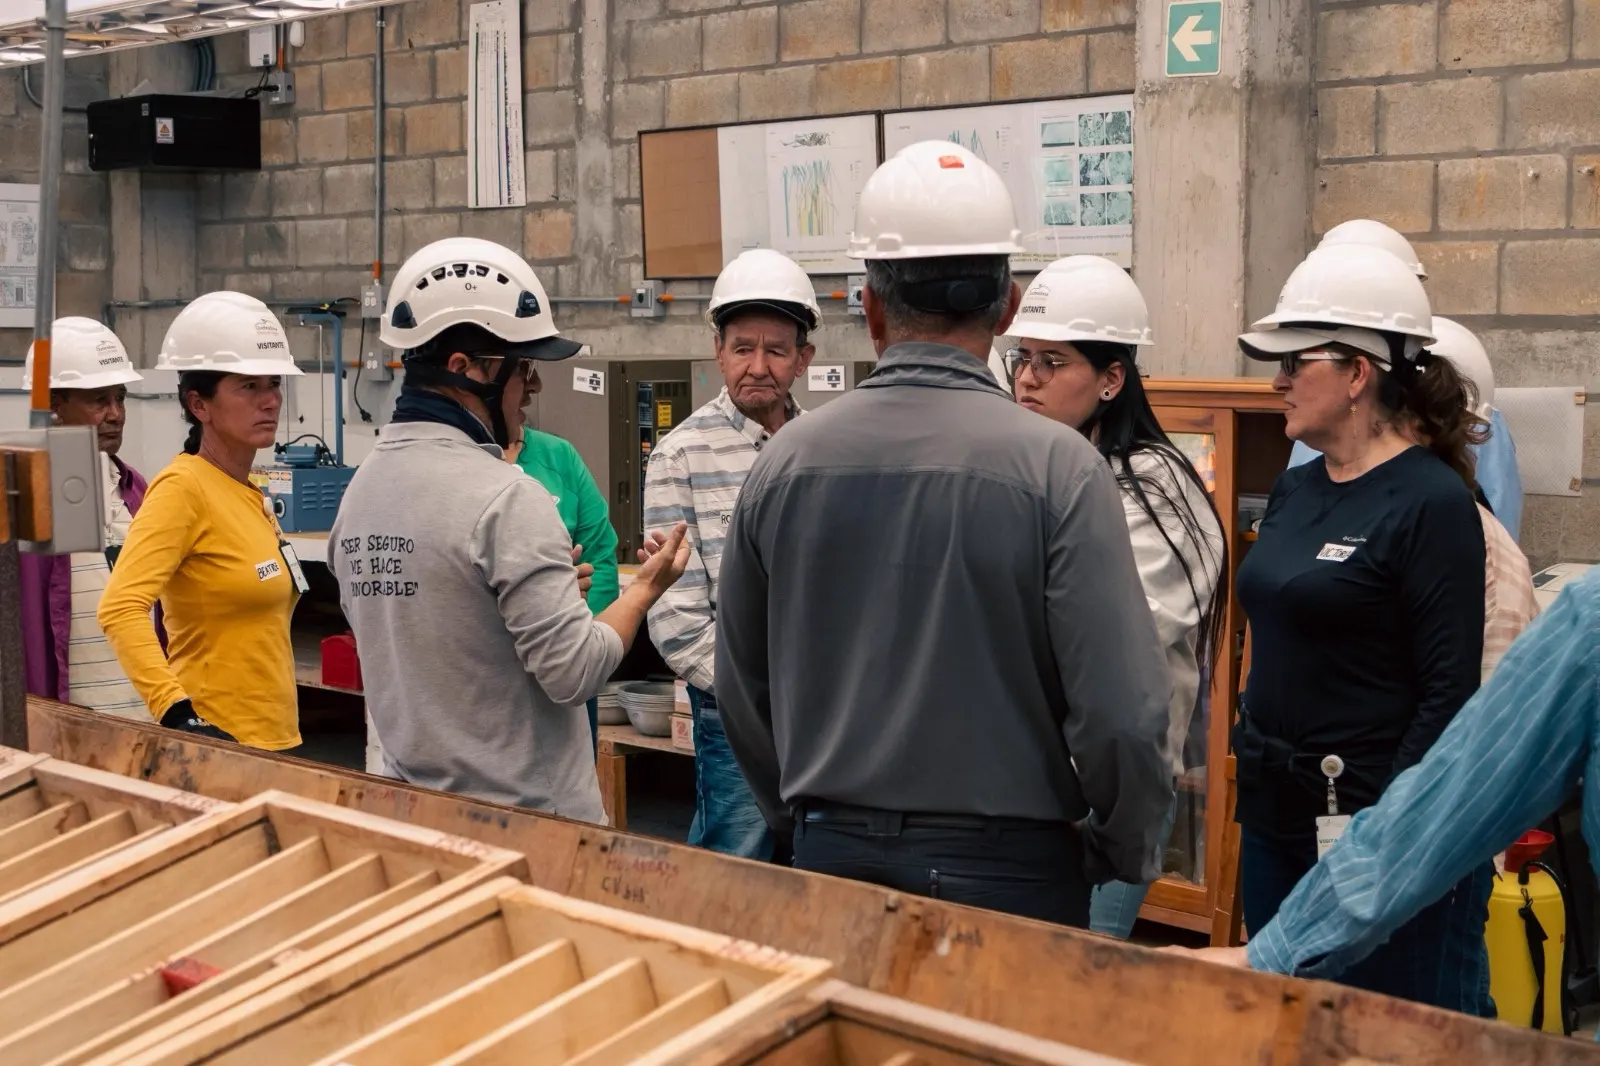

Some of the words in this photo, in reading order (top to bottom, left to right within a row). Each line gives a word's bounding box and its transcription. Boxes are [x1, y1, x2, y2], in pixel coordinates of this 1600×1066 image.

[257, 341, 285, 350] VISITANTE
[99, 356, 124, 366] VISITANTE
[367, 534, 415, 554] SEGURO
[370, 556, 402, 575] HACE
